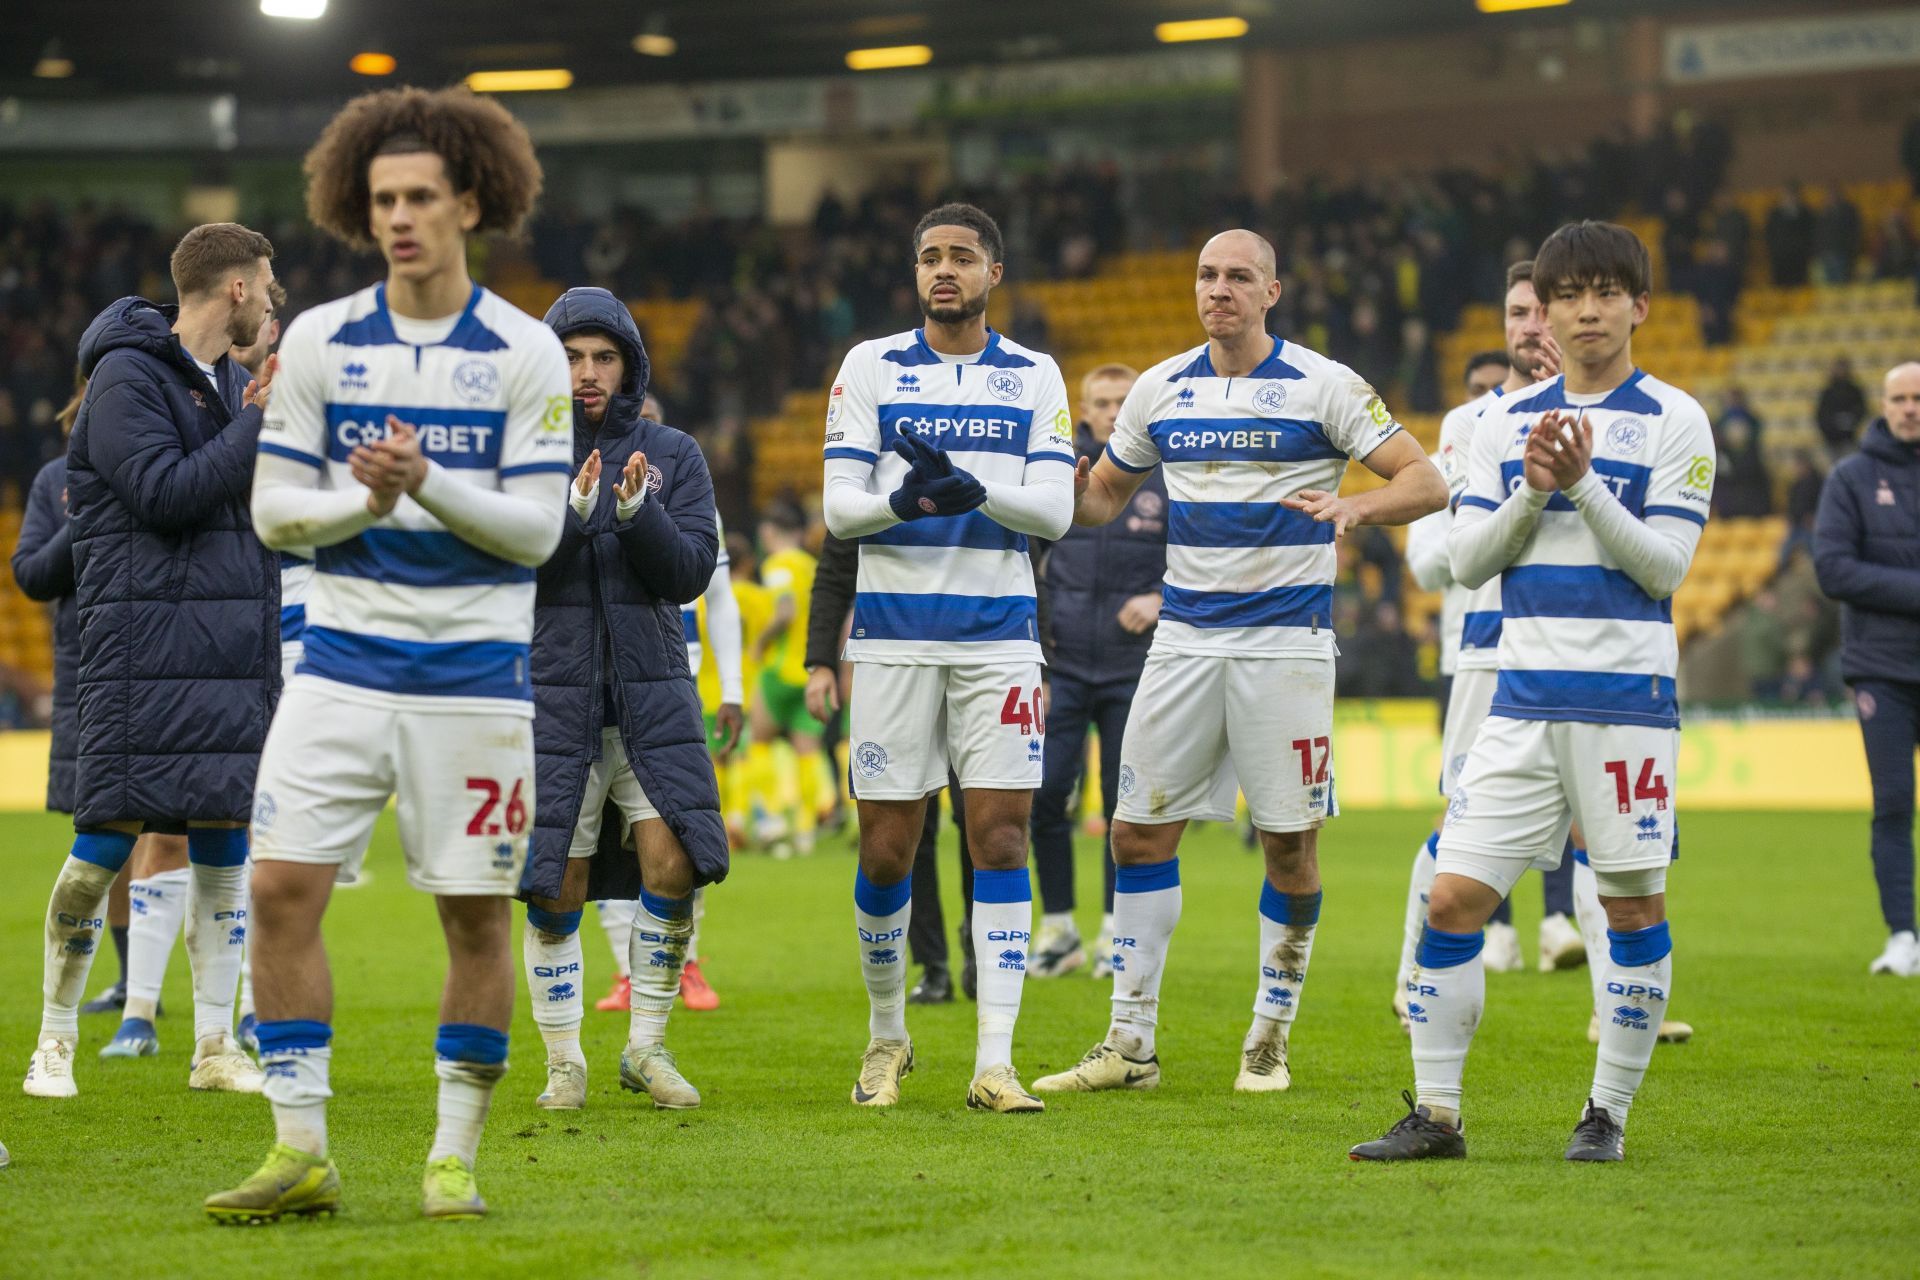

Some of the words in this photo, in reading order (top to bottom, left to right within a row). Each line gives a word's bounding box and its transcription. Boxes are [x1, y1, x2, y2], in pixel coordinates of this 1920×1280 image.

[1168, 430, 1282, 449] COPYBET
[1000, 686, 1045, 735] 40
[1292, 736, 1329, 785] 12
[1605, 757, 1668, 814] 14
[466, 777, 527, 836] 26
[57, 912, 103, 929] QPR
[214, 910, 246, 921] QP
[858, 927, 903, 944] QPR
[987, 930, 1030, 944] QPR
[1112, 937, 1136, 948] PR
[869, 955, 898, 965] errea
[998, 961, 1025, 970] errea
[533, 962, 579, 977] QPR
[1262, 966, 1304, 983] QPR
[548, 991, 576, 1001] errea
[1407, 981, 1439, 997] PR
[1607, 982, 1664, 1001] QPR
[1265, 996, 1292, 1007] errea
[1612, 1016, 1648, 1030] errea
